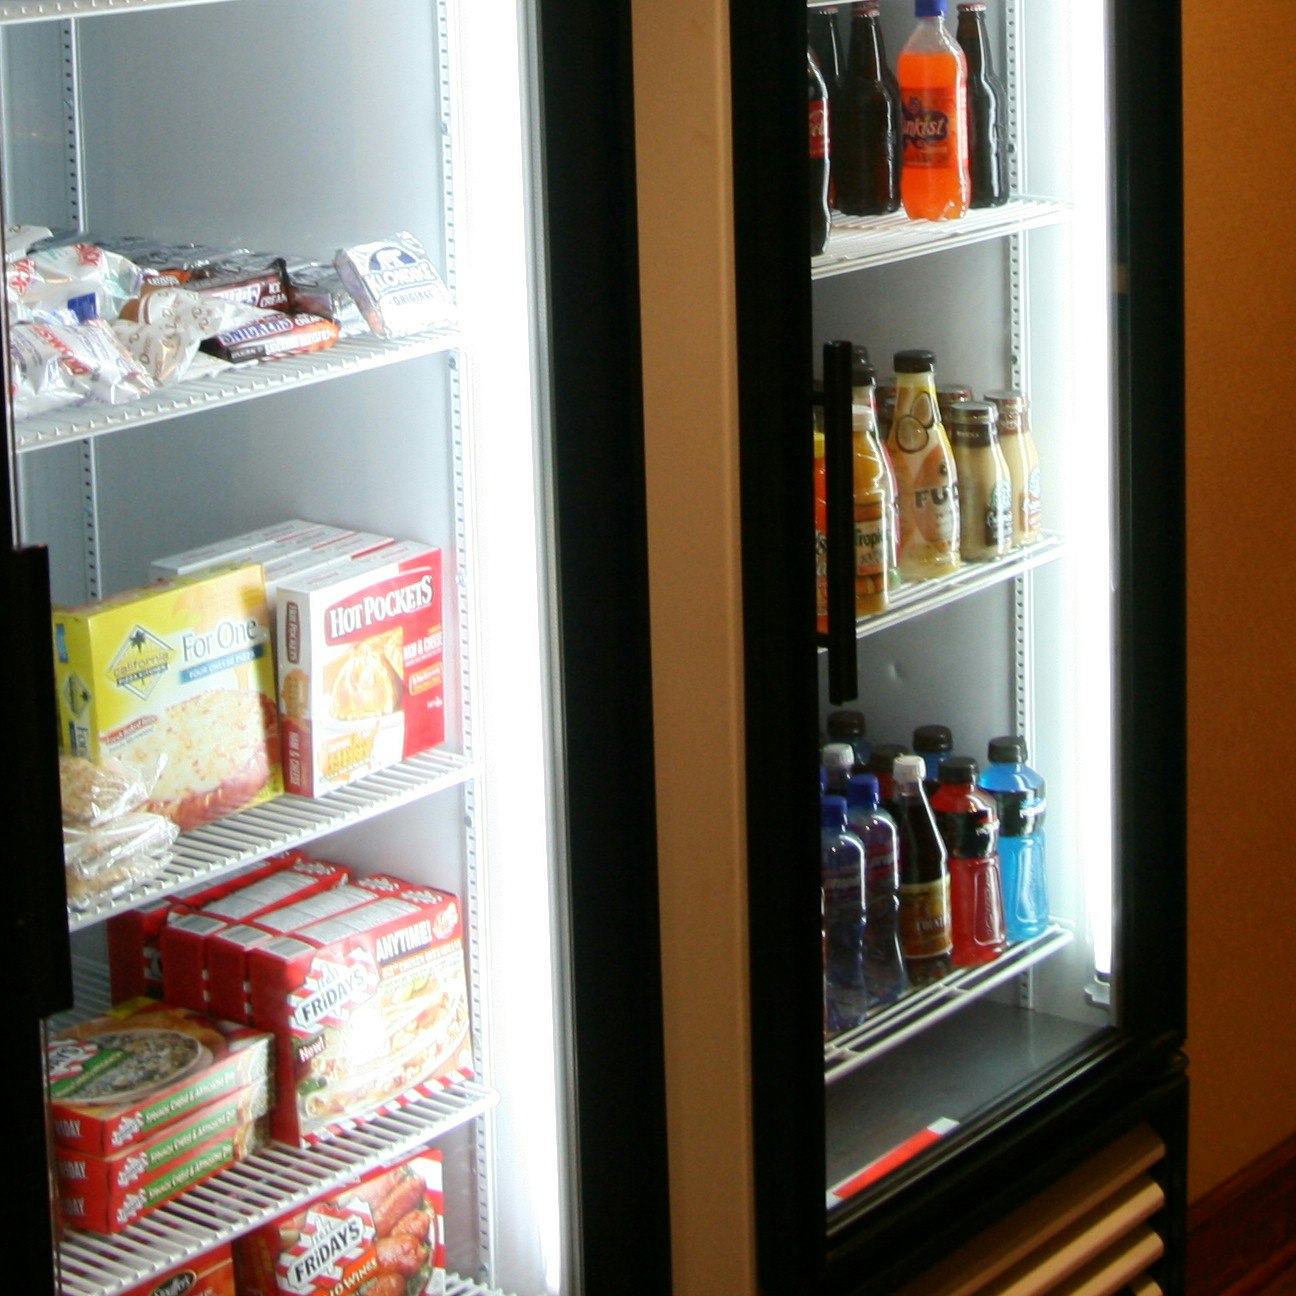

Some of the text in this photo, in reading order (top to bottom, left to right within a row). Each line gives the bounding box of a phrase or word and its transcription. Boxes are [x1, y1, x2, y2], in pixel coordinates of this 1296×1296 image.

[904, 117, 945, 138] nkist
[330, 575, 433, 639] HOT POCKETS
[182, 620, 257, 662] For One
[376, 918, 433, 964] ANYTIME!
[301, 966, 365, 1023] FRIDAYS
[299, 1033, 327, 1063] New!
[294, 1221, 361, 1283] FRIDAYS
